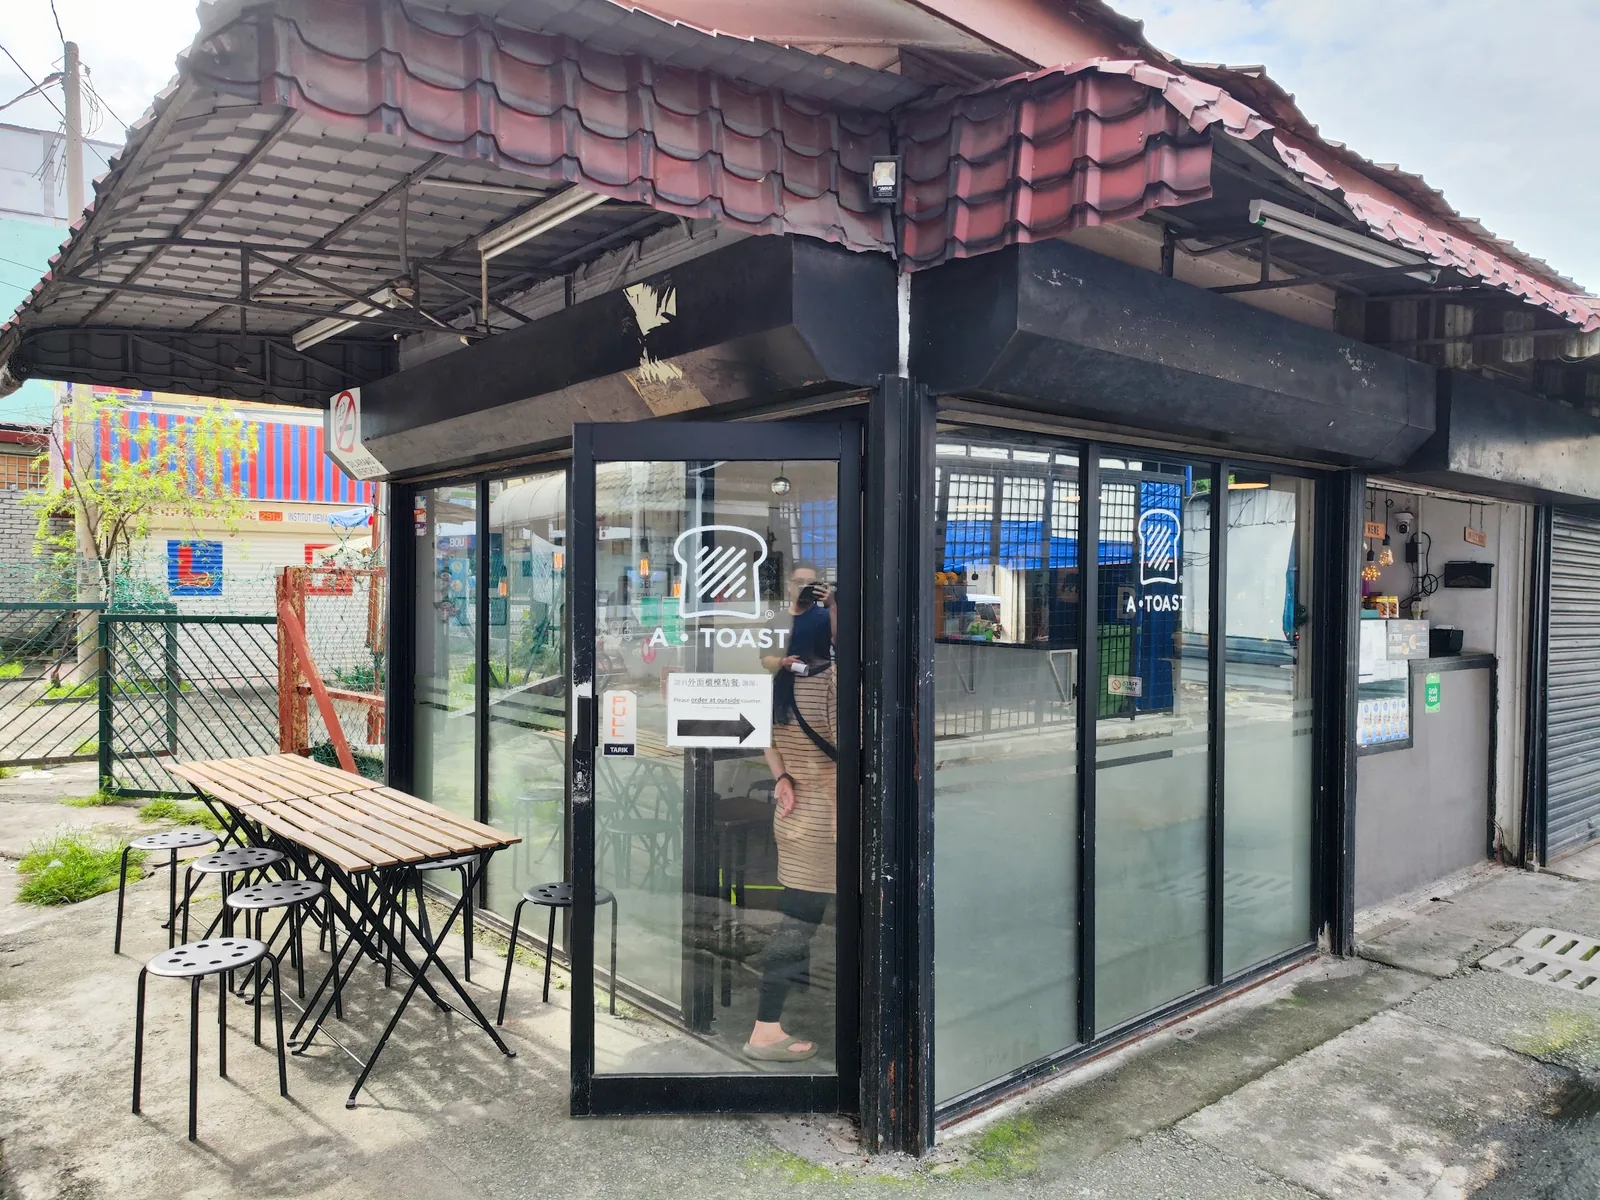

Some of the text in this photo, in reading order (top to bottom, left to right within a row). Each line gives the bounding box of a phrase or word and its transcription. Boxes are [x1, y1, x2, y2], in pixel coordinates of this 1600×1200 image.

[288, 512, 312, 522] INSTITUT
[1145, 595, 1187, 612] TOAST
[700, 628, 790, 648] TOAST
[611, 696, 627, 738] PULL
